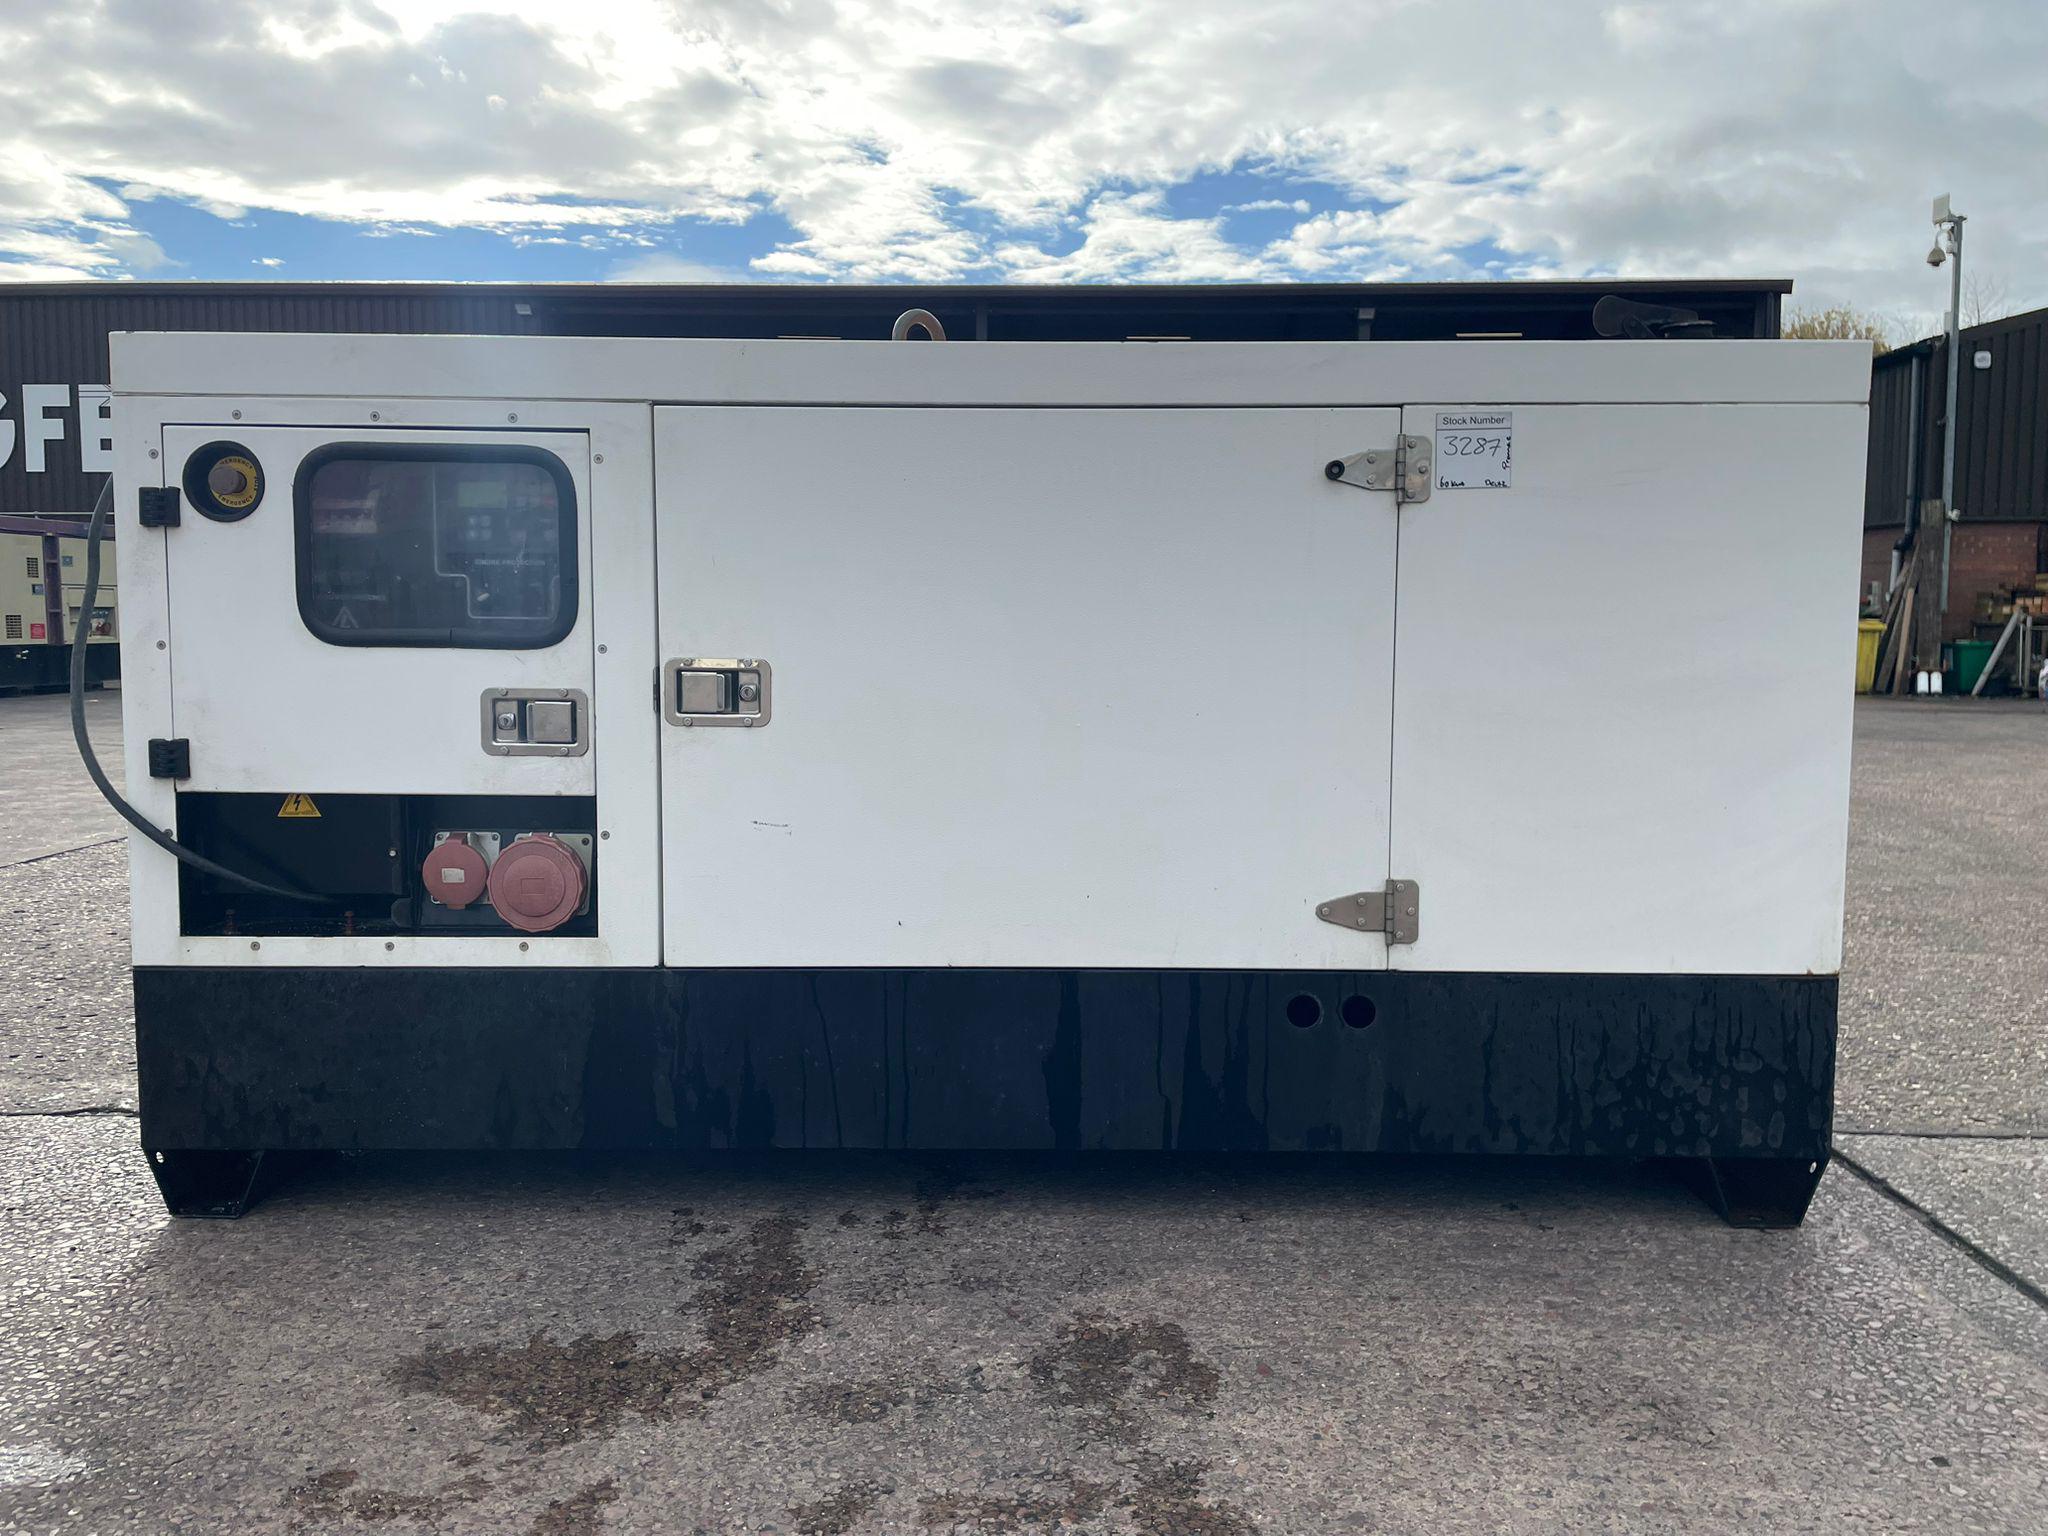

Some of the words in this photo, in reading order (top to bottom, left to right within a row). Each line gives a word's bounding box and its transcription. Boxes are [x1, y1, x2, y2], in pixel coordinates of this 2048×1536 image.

[0, 384, 113, 472] FE
[1442, 416, 1467, 425] Stock
[1470, 416, 1504, 424] Number
[1444, 436, 1501, 456] 3287
